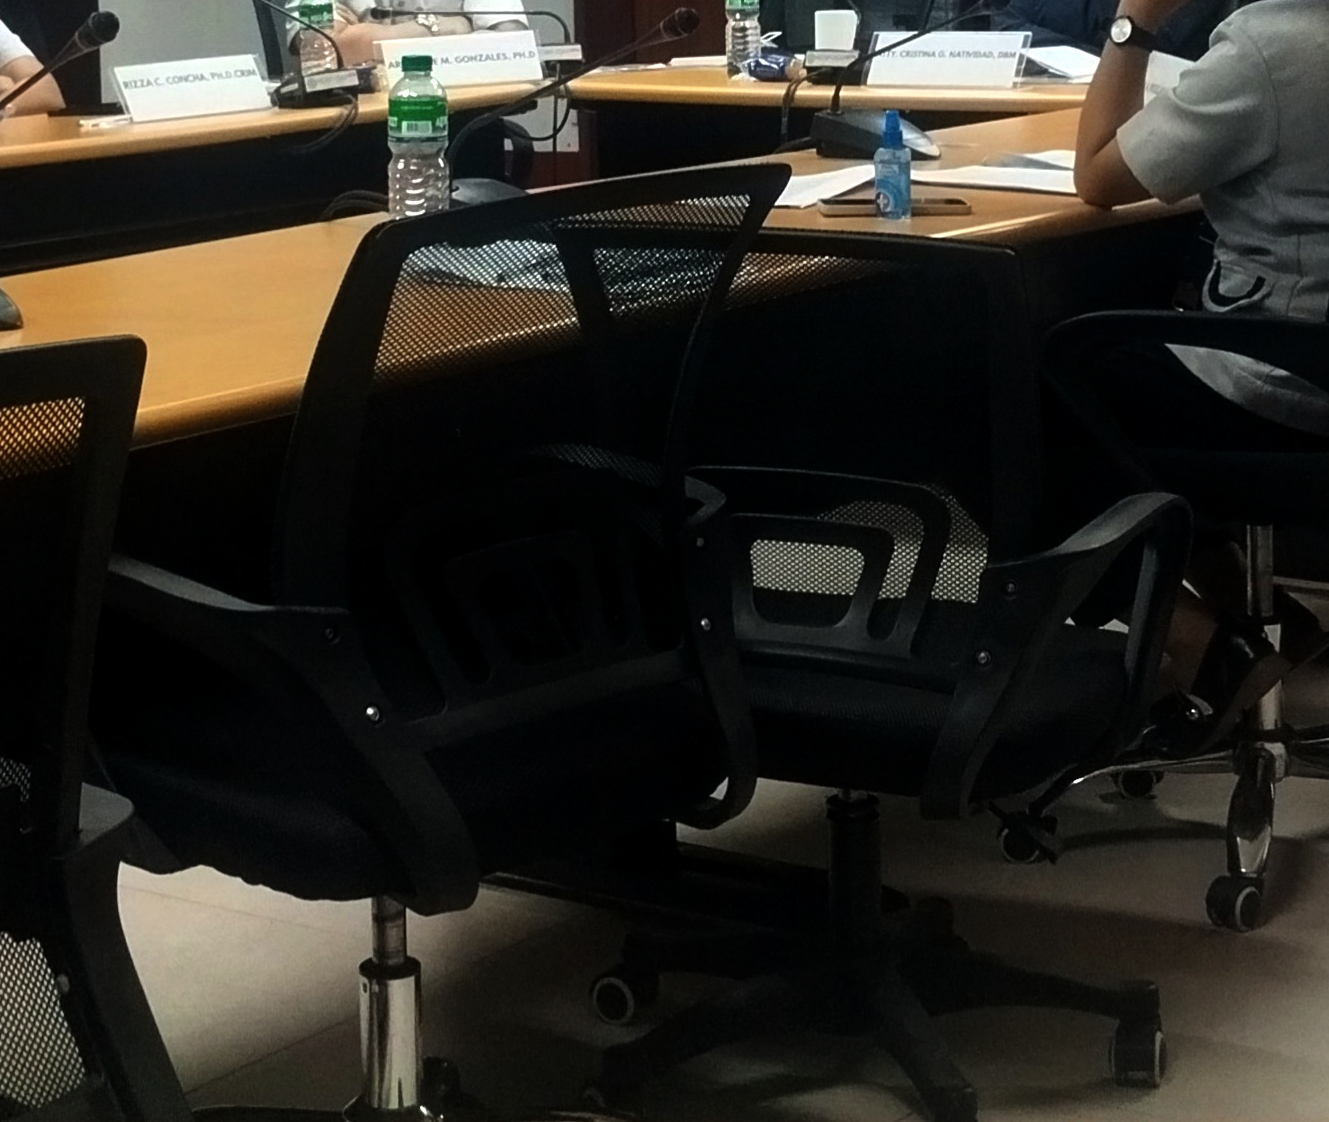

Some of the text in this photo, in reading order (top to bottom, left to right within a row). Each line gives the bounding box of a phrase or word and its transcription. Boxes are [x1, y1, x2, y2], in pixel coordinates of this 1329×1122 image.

[441, 56, 452, 65] M.
[455, 52, 511, 64] GONZALES,
[899, 50, 936, 58] CRISTINA
[949, 50, 996, 59] NATIVIDAD,
[123, 77, 154, 90] RIZZA
